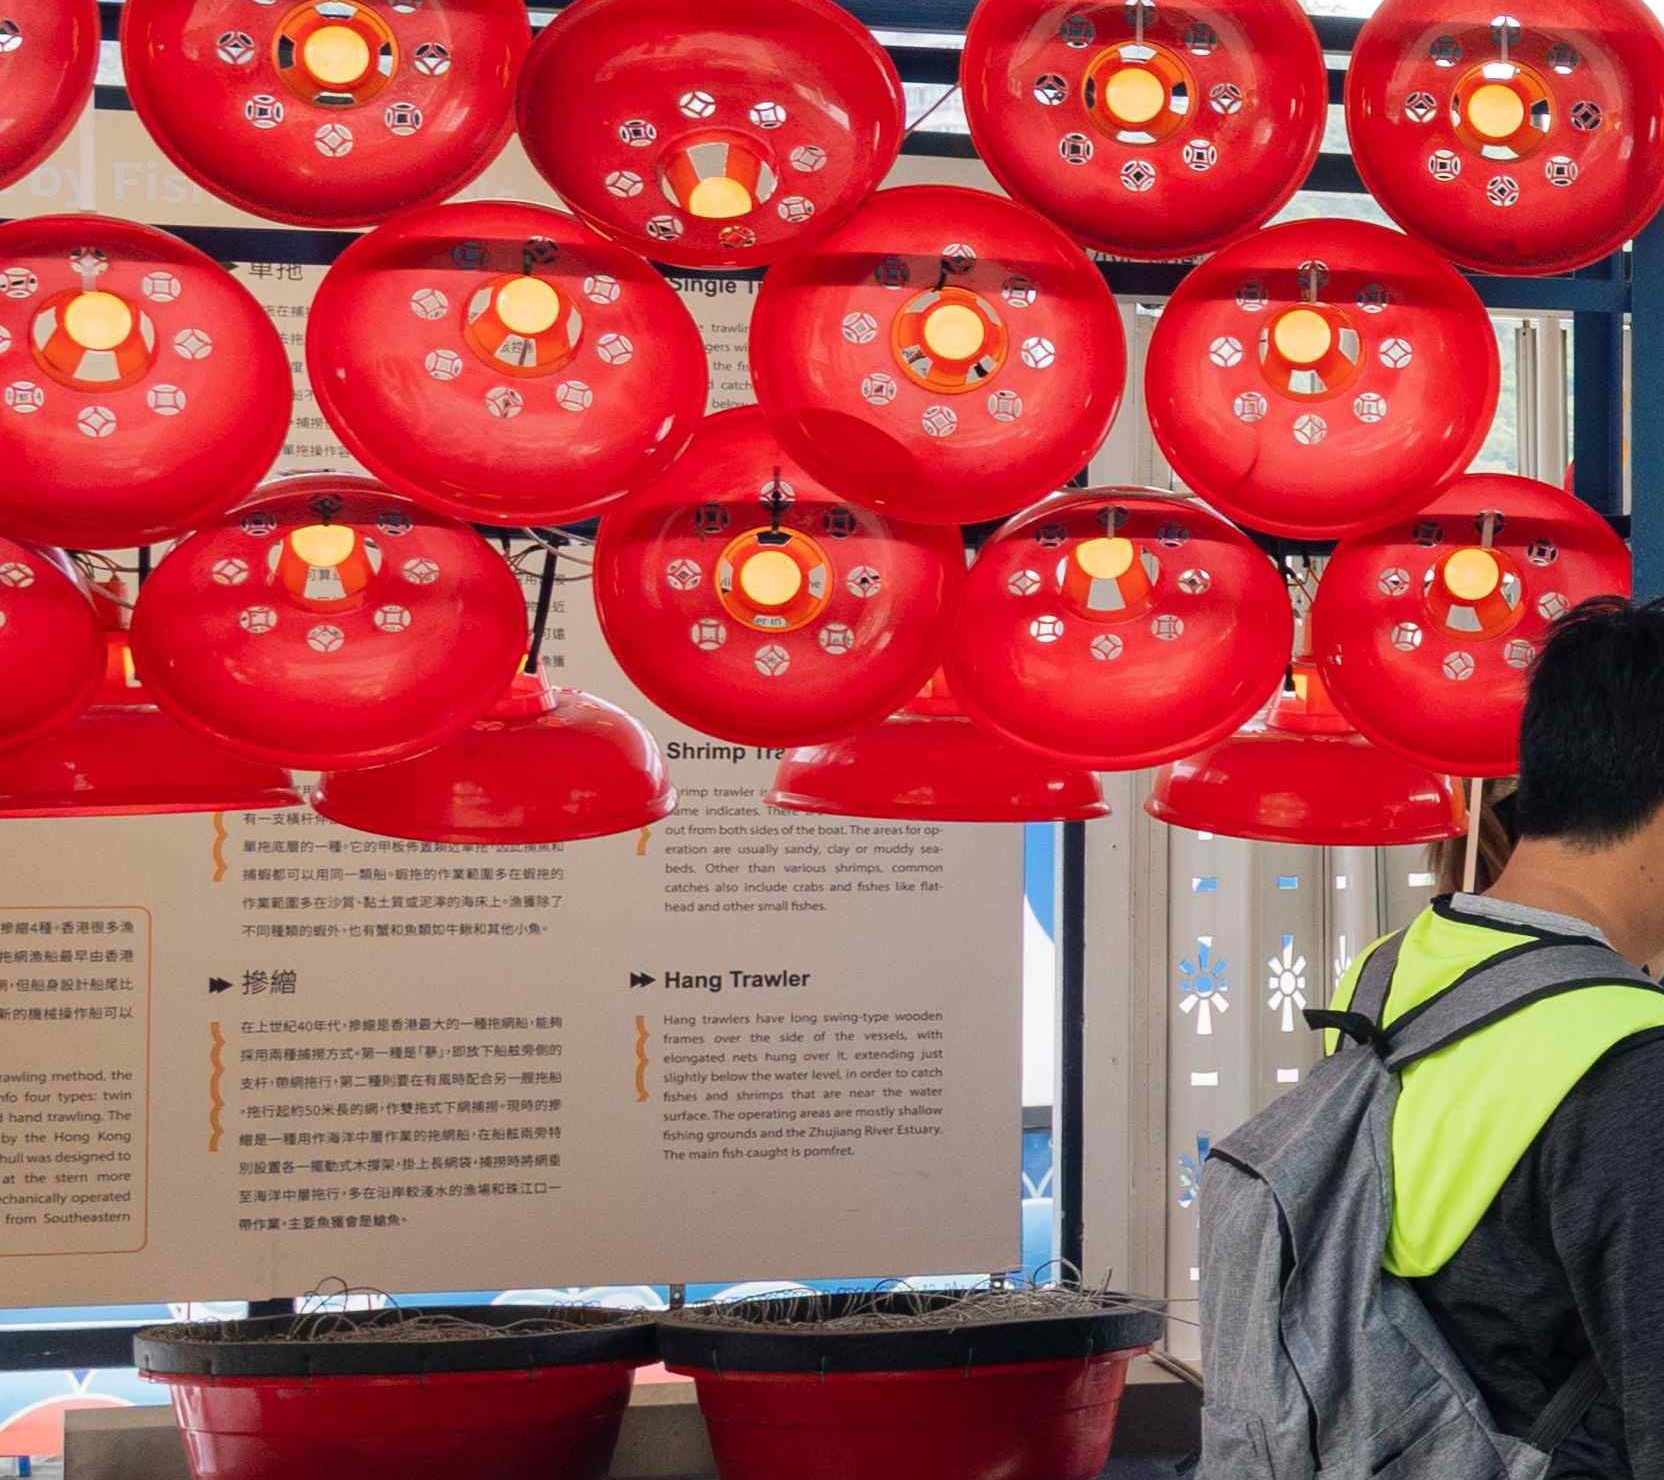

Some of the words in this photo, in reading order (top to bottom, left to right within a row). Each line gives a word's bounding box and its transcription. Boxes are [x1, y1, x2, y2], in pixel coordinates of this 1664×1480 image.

[666, 741, 747, 764] Shrimp
[664, 902, 694, 912] head
[696, 902, 720, 911] and
[722, 901, 755, 911] other
[757, 901, 788, 911] small
[790, 901, 827, 911] fishes.
[664, 971, 723, 993] Hang
[730, 969, 811, 988] Trawler
[663, 1015, 696, 1027] Hang
[701, 1015, 750, 1024] trawlers
[756, 1013, 785, 1023] have
[790, 1013, 817, 1025] long
[823, 1013, 889, 1024] swing-type
[894, 1011, 943, 1021] wooden
